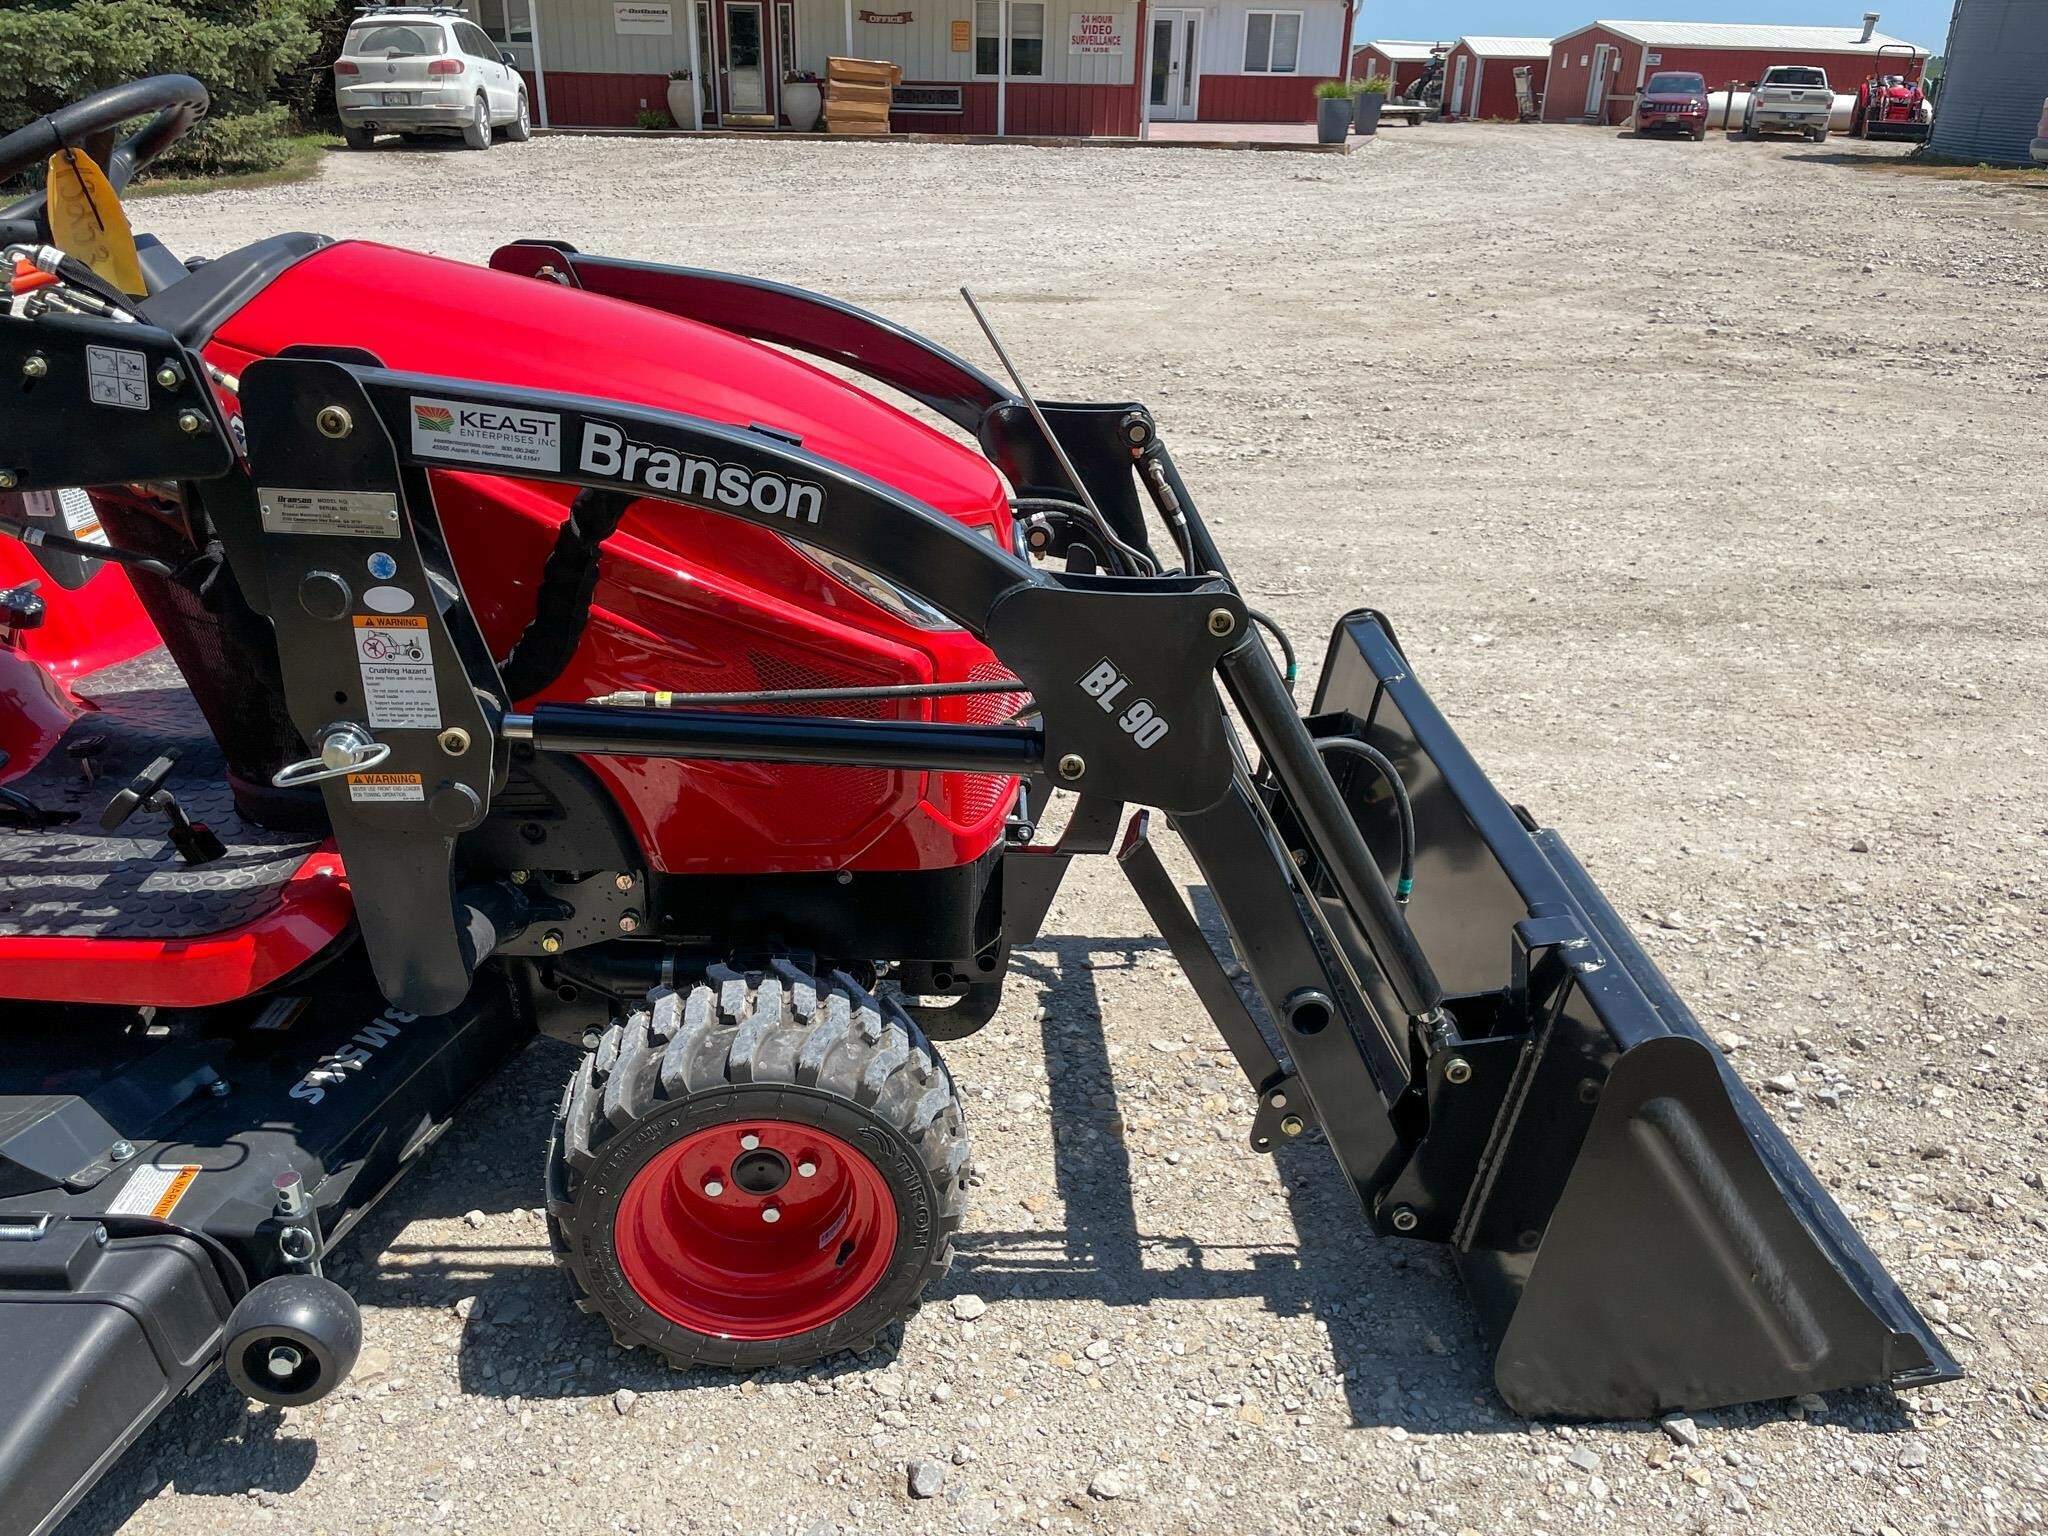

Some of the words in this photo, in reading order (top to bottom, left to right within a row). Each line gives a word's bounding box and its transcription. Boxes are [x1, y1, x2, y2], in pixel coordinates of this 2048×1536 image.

[869, 15, 904, 23] OFFICE
[1081, 15, 1090, 24] 24
[1091, 15, 1113, 24] HOUR
[1081, 25, 1113, 35] VIDEO
[1072, 35, 1121, 46] SURVEILLANCE
[460, 410, 556, 437] KEAST
[460, 428, 534, 445] ENTERPRISES
[538, 438, 556, 448] INC
[579, 421, 823, 524] Branson
[277, 495, 312, 504] Branson
[376, 618, 418, 627] WARNING
[368, 667, 400, 675] Crushing
[402, 667, 427, 675] Hazard
[1079, 661, 1128, 713] BL
[1119, 701, 1169, 749] 90
[365, 775, 417, 784] WARNING
[154, 1181, 185, 1217] WARNIN
